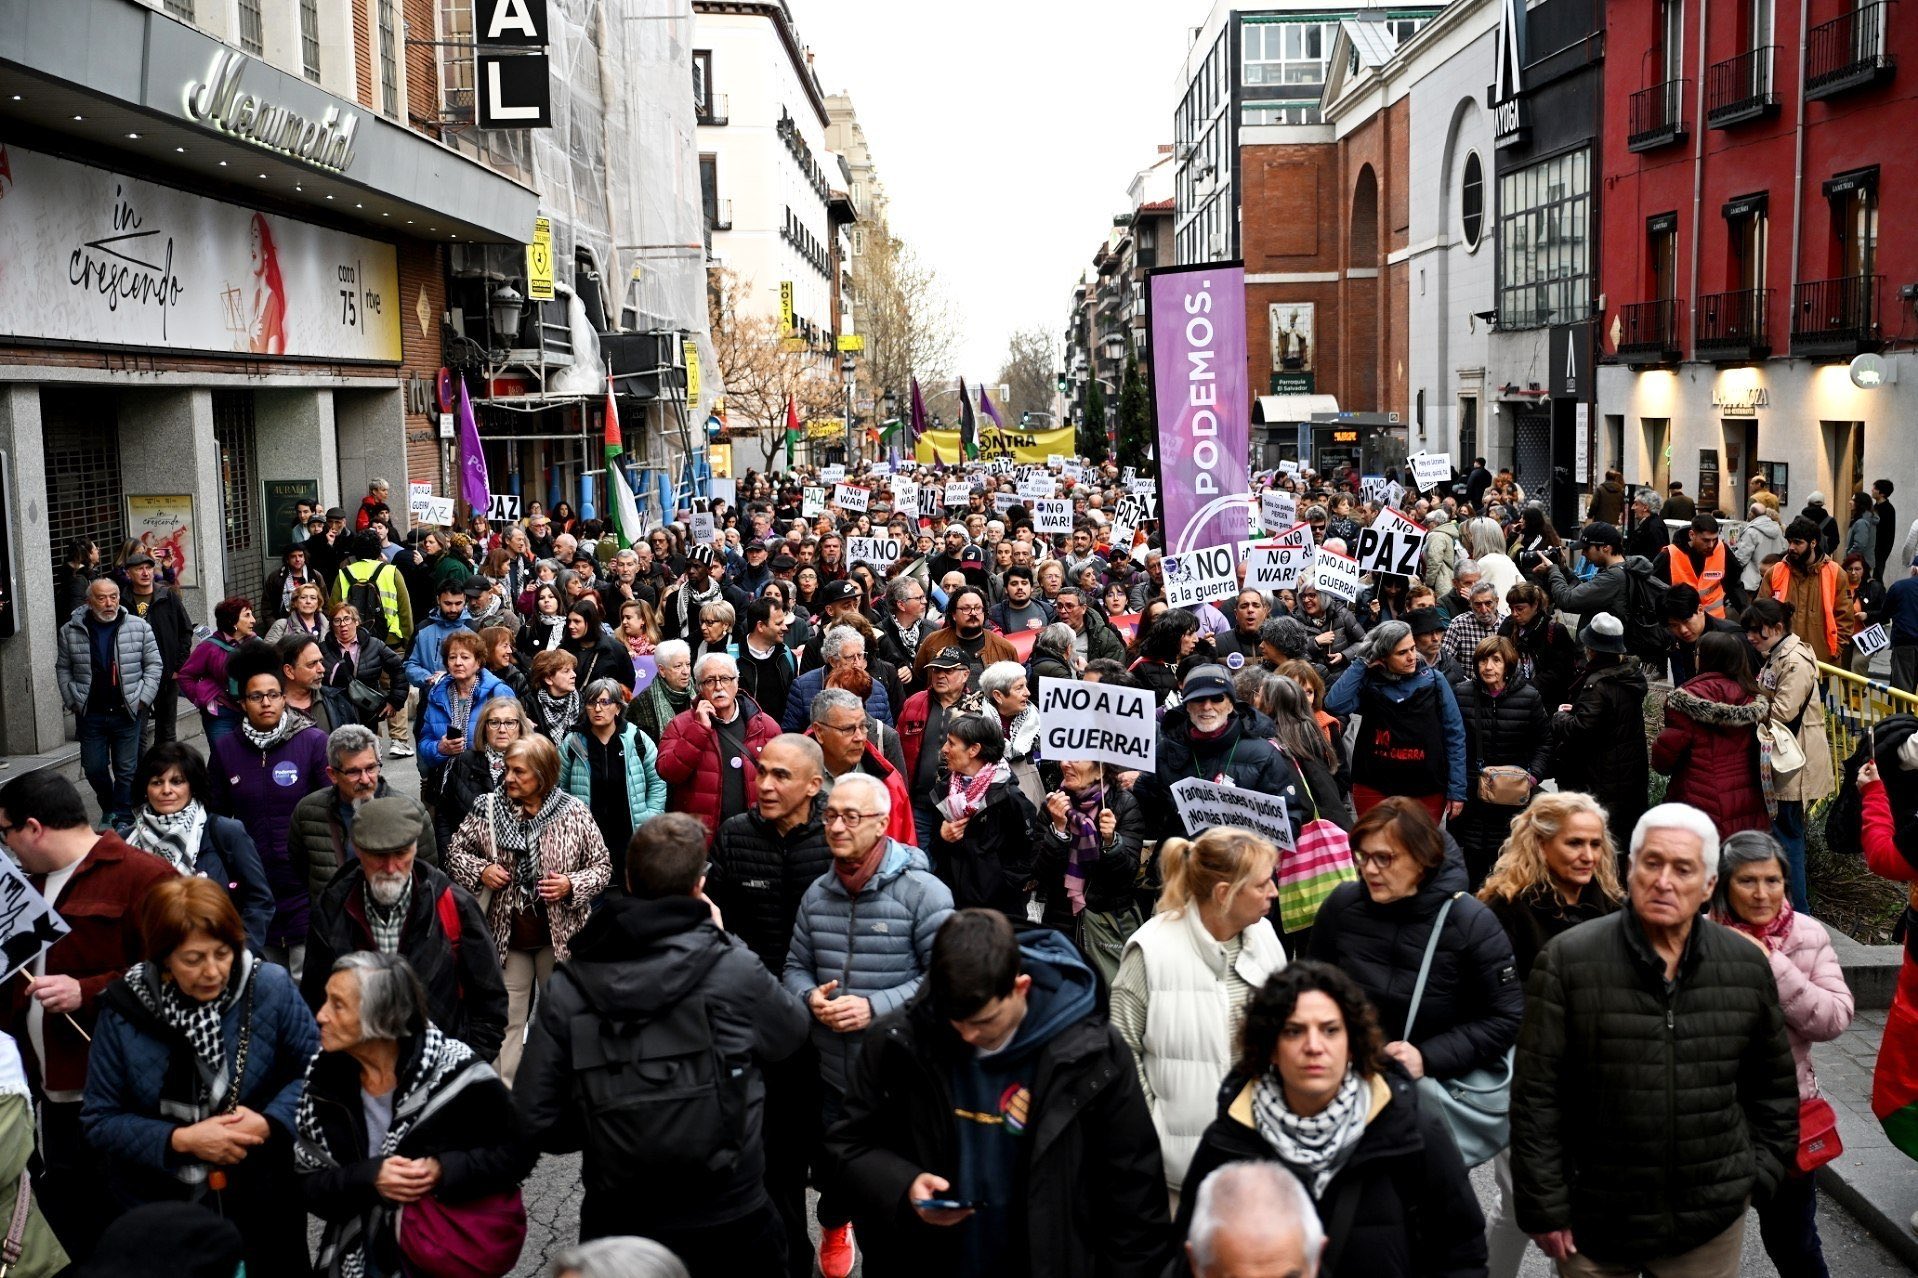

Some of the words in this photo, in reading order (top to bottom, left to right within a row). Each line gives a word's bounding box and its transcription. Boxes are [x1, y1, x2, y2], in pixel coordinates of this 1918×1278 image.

[189, 51, 360, 172] Monumental
[113, 184, 142, 231] in
[338, 264, 354, 284] coro
[69, 237, 183, 341] crescendo
[340, 289, 356, 326] 75
[1184, 280, 1219, 494] PODEMOS.
[804, 488, 824, 505] PAZ
[840, 495, 865, 507] WAR!
[846, 487, 861, 497] NO
[902, 487, 913, 496] NO
[1046, 502, 1064, 514] NO
[1115, 500, 1141, 530] PAZ
[1041, 516, 1070, 527] WAR!
[1284, 530, 1303, 546] NO
[873, 540, 898, 561] NO
[1266, 550, 1291, 565] NO
[1357, 528, 1422, 576] PAZ
[1196, 548, 1231, 580] NO
[1257, 567, 1297, 583] WAR!
[1338, 560, 1344, 571] A
[1346, 562, 1356, 576] LA
[1170, 592, 1178, 603] a
[1180, 586, 1191, 601] la
[1195, 580, 1236, 602] guerra
[1320, 574, 1356, 599] GUERRA!
[1043, 687, 1091, 713] ¡NO
[1094, 692, 1111, 714] A
[1116, 694, 1144, 720] LA
[1048, 727, 1150, 759] GUERRA!
[1177, 785, 1220, 804] Yanquis,
[1248, 801, 1256, 811] o
[1187, 808, 1204, 831] ¡No
[1204, 809, 1222, 826] más
[1222, 812, 1255, 830] pueblos
